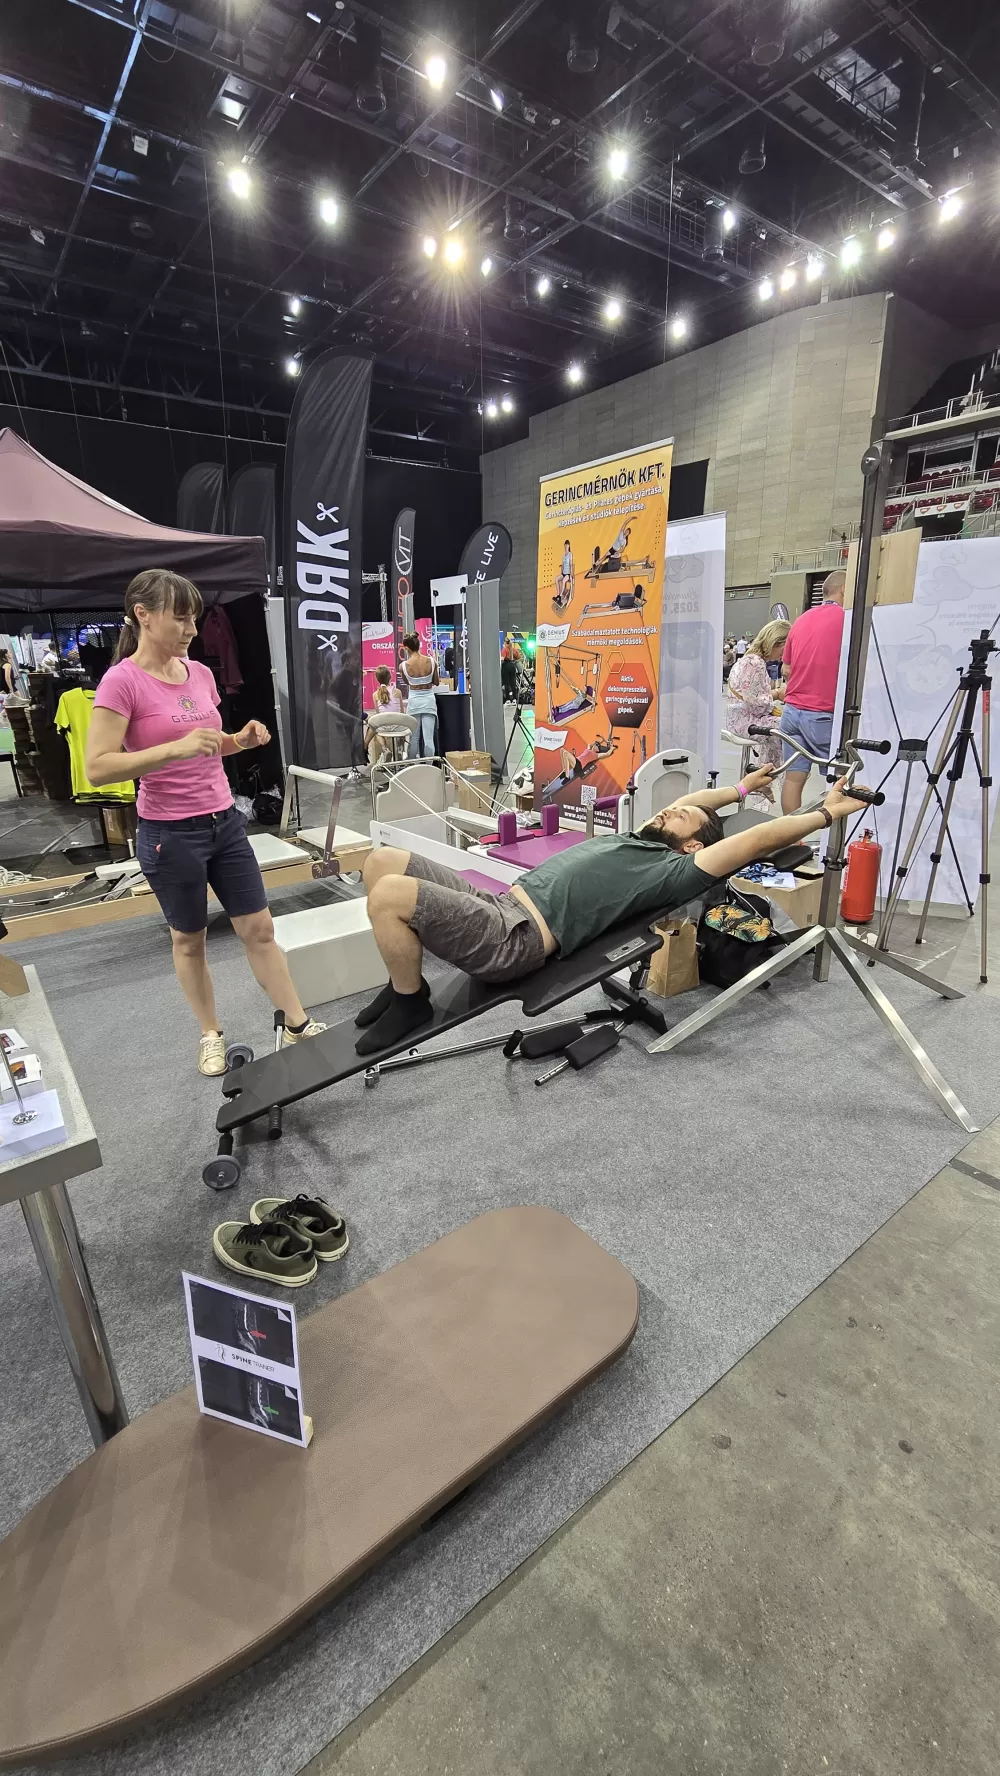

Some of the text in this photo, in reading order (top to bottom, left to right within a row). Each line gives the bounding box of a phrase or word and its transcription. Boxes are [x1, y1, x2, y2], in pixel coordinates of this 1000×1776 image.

[545, 462, 666, 507] GERINCMÉRNÖK KFT.
[593, 498, 613, 509] Pilates
[614, 492, 633, 505] gépek
[634, 486, 664, 501] gyártása,
[582, 513, 590, 522] és
[481, 531, 499, 566] LIVE
[571, 629, 621, 637] Szabadalmaztatott
[586, 637, 643, 646] mérnöki megoldások.
[605, 696, 649, 704] gerincgyógyászati
[617, 706, 634, 714] gépek.
[171, 710, 217, 723] GENIUS
[231, 1354, 252, 1365] SPINE
